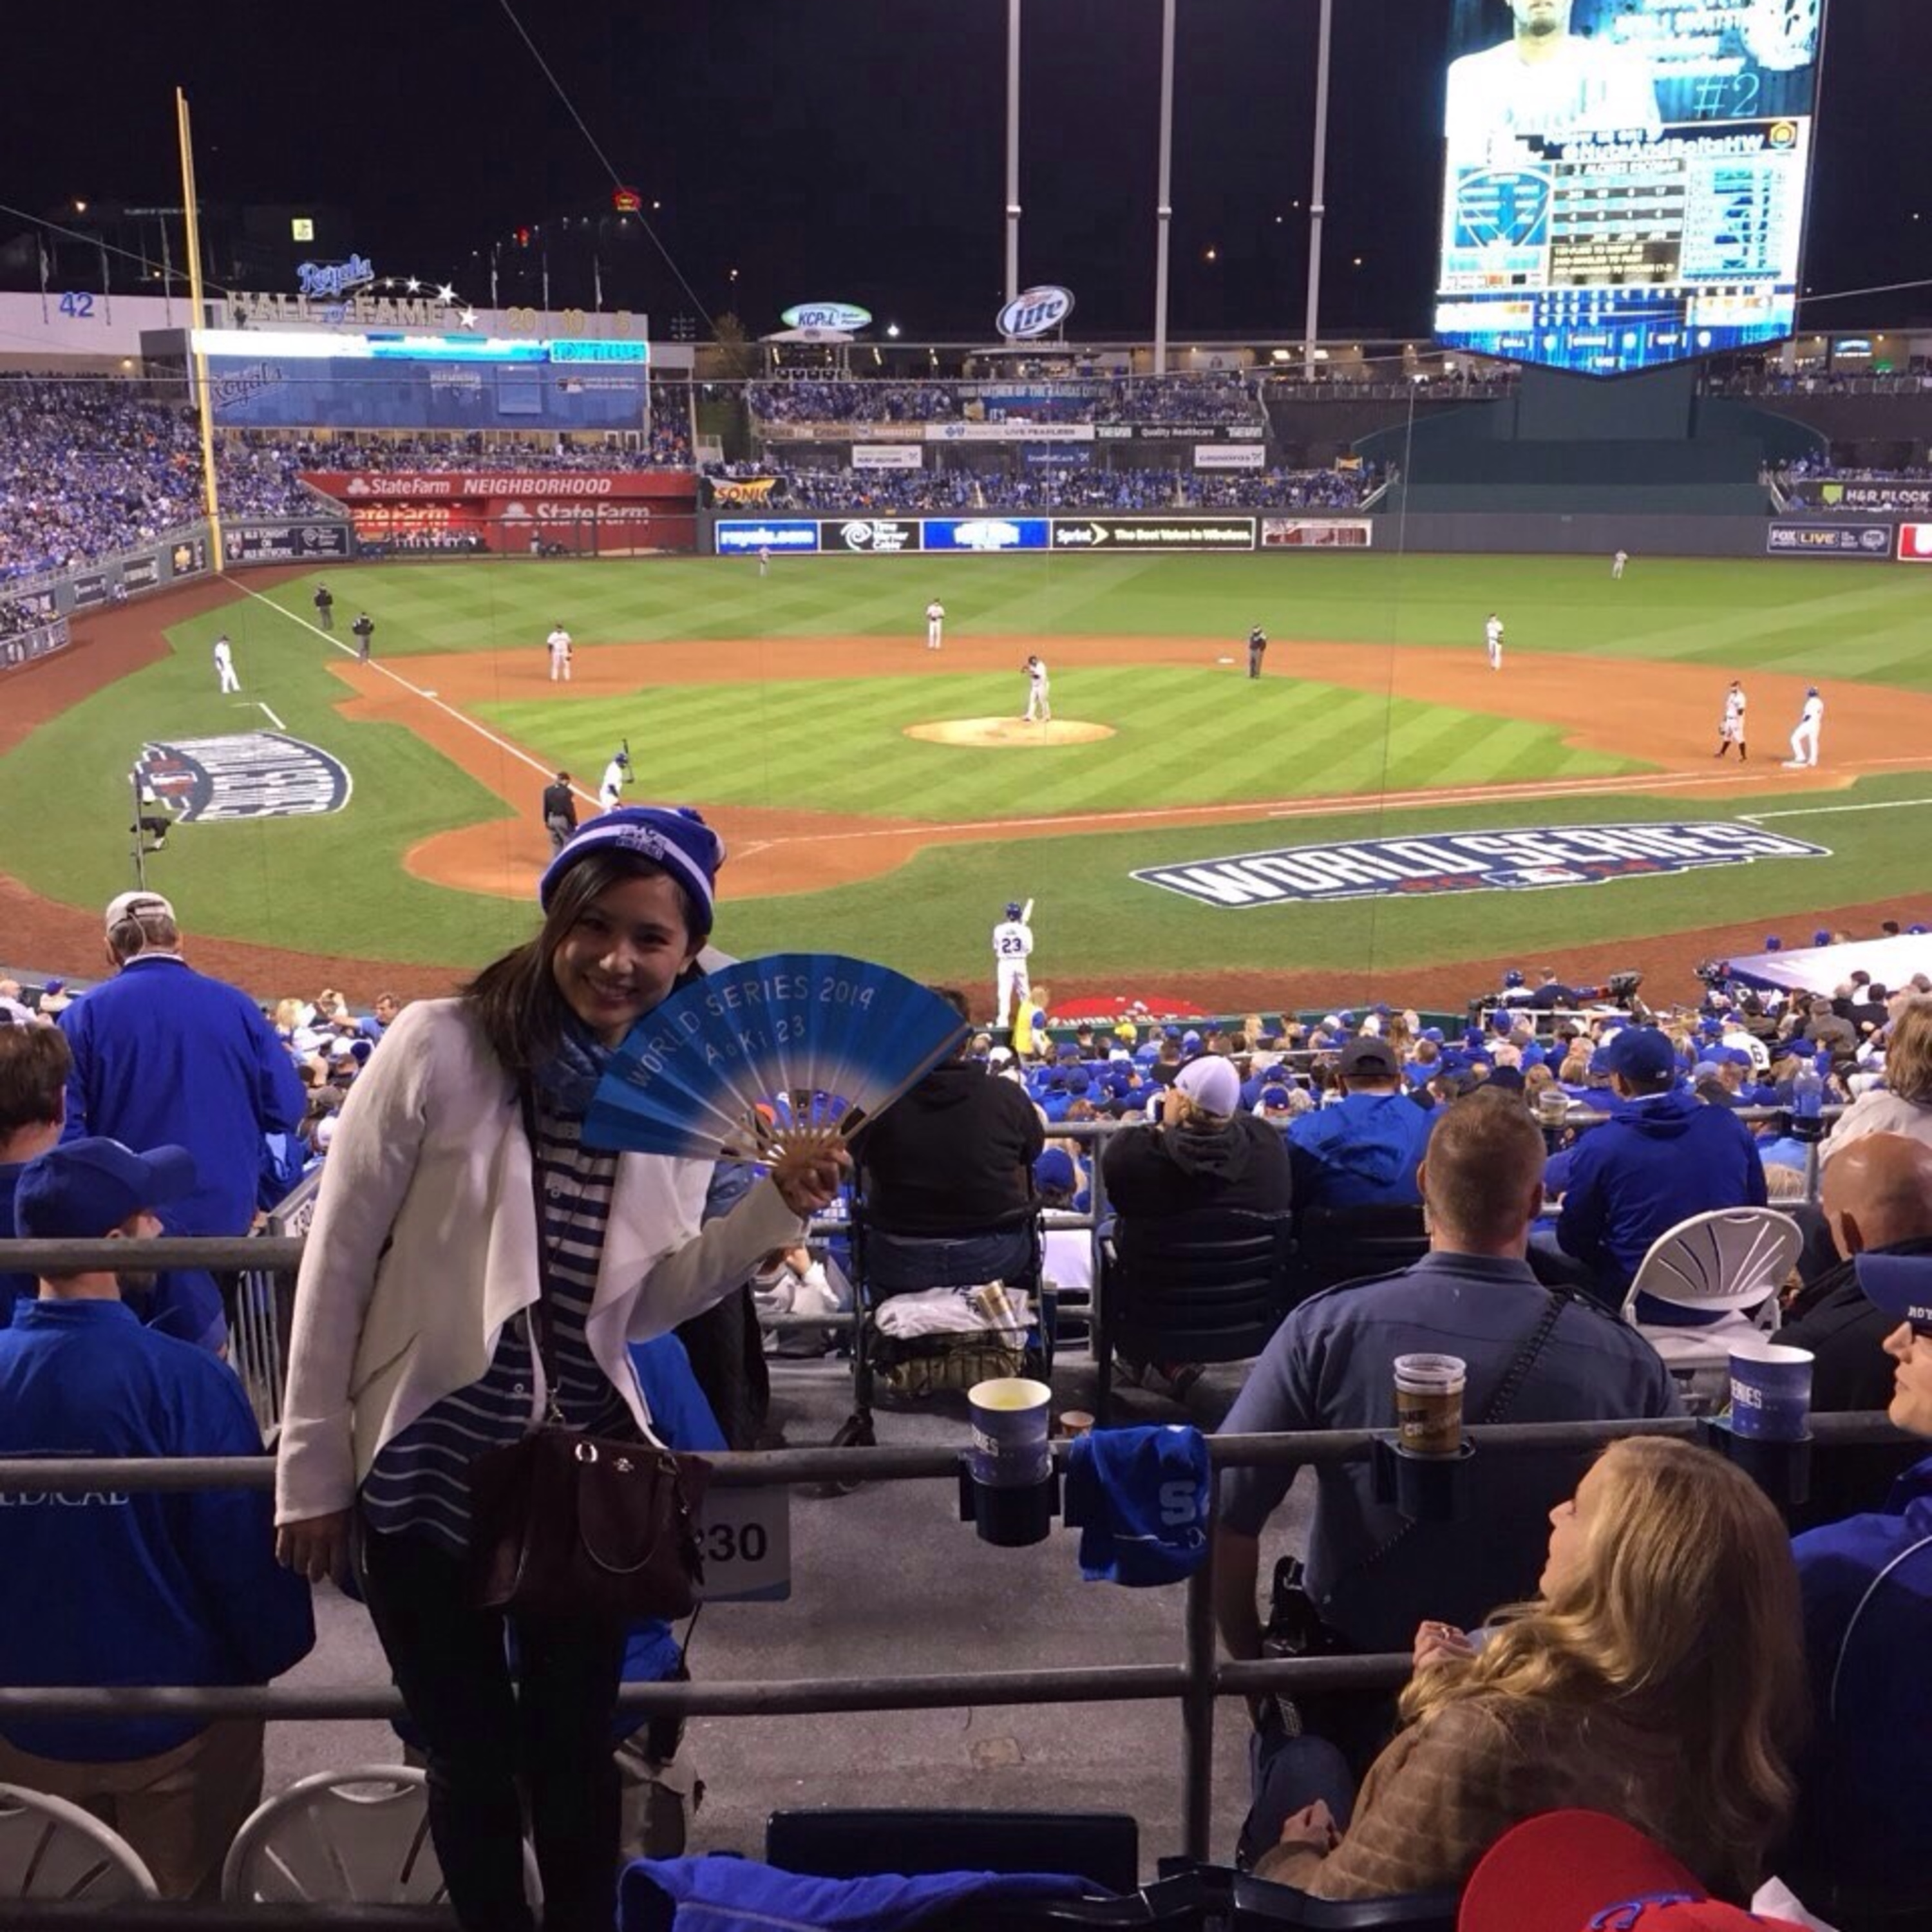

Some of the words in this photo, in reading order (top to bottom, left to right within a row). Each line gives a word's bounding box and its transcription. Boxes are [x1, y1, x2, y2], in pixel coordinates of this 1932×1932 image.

[1694, 72, 1760, 118] #2
[297, 253, 375, 298] Royals
[59, 292, 94, 317] 42
[355, 296, 446, 325] FAME
[1012, 299, 1063, 334] Lite
[1141, 427, 1170, 438] Quality
[1172, 427, 1215, 437] Healthcare
[462, 478, 612, 495] NEIGHBORHOOD
[1056, 528, 1092, 544] Sprint
[1114, 529, 1135, 540] The
[1772, 529, 1796, 541] FOX
[1800, 533, 1835, 544] LIVE
[1153, 840, 1494, 904] WORLD
[1450, 824, 1814, 867] SERIES
[1001, 938, 1022, 954] 23
[627, 1010, 702, 1088] WORLD
[705, 974, 809, 1017] SERIES
[819, 976, 875, 1010] 2014
[776, 1015, 805, 1043] 23
[701, 1522, 767, 1563] 30
